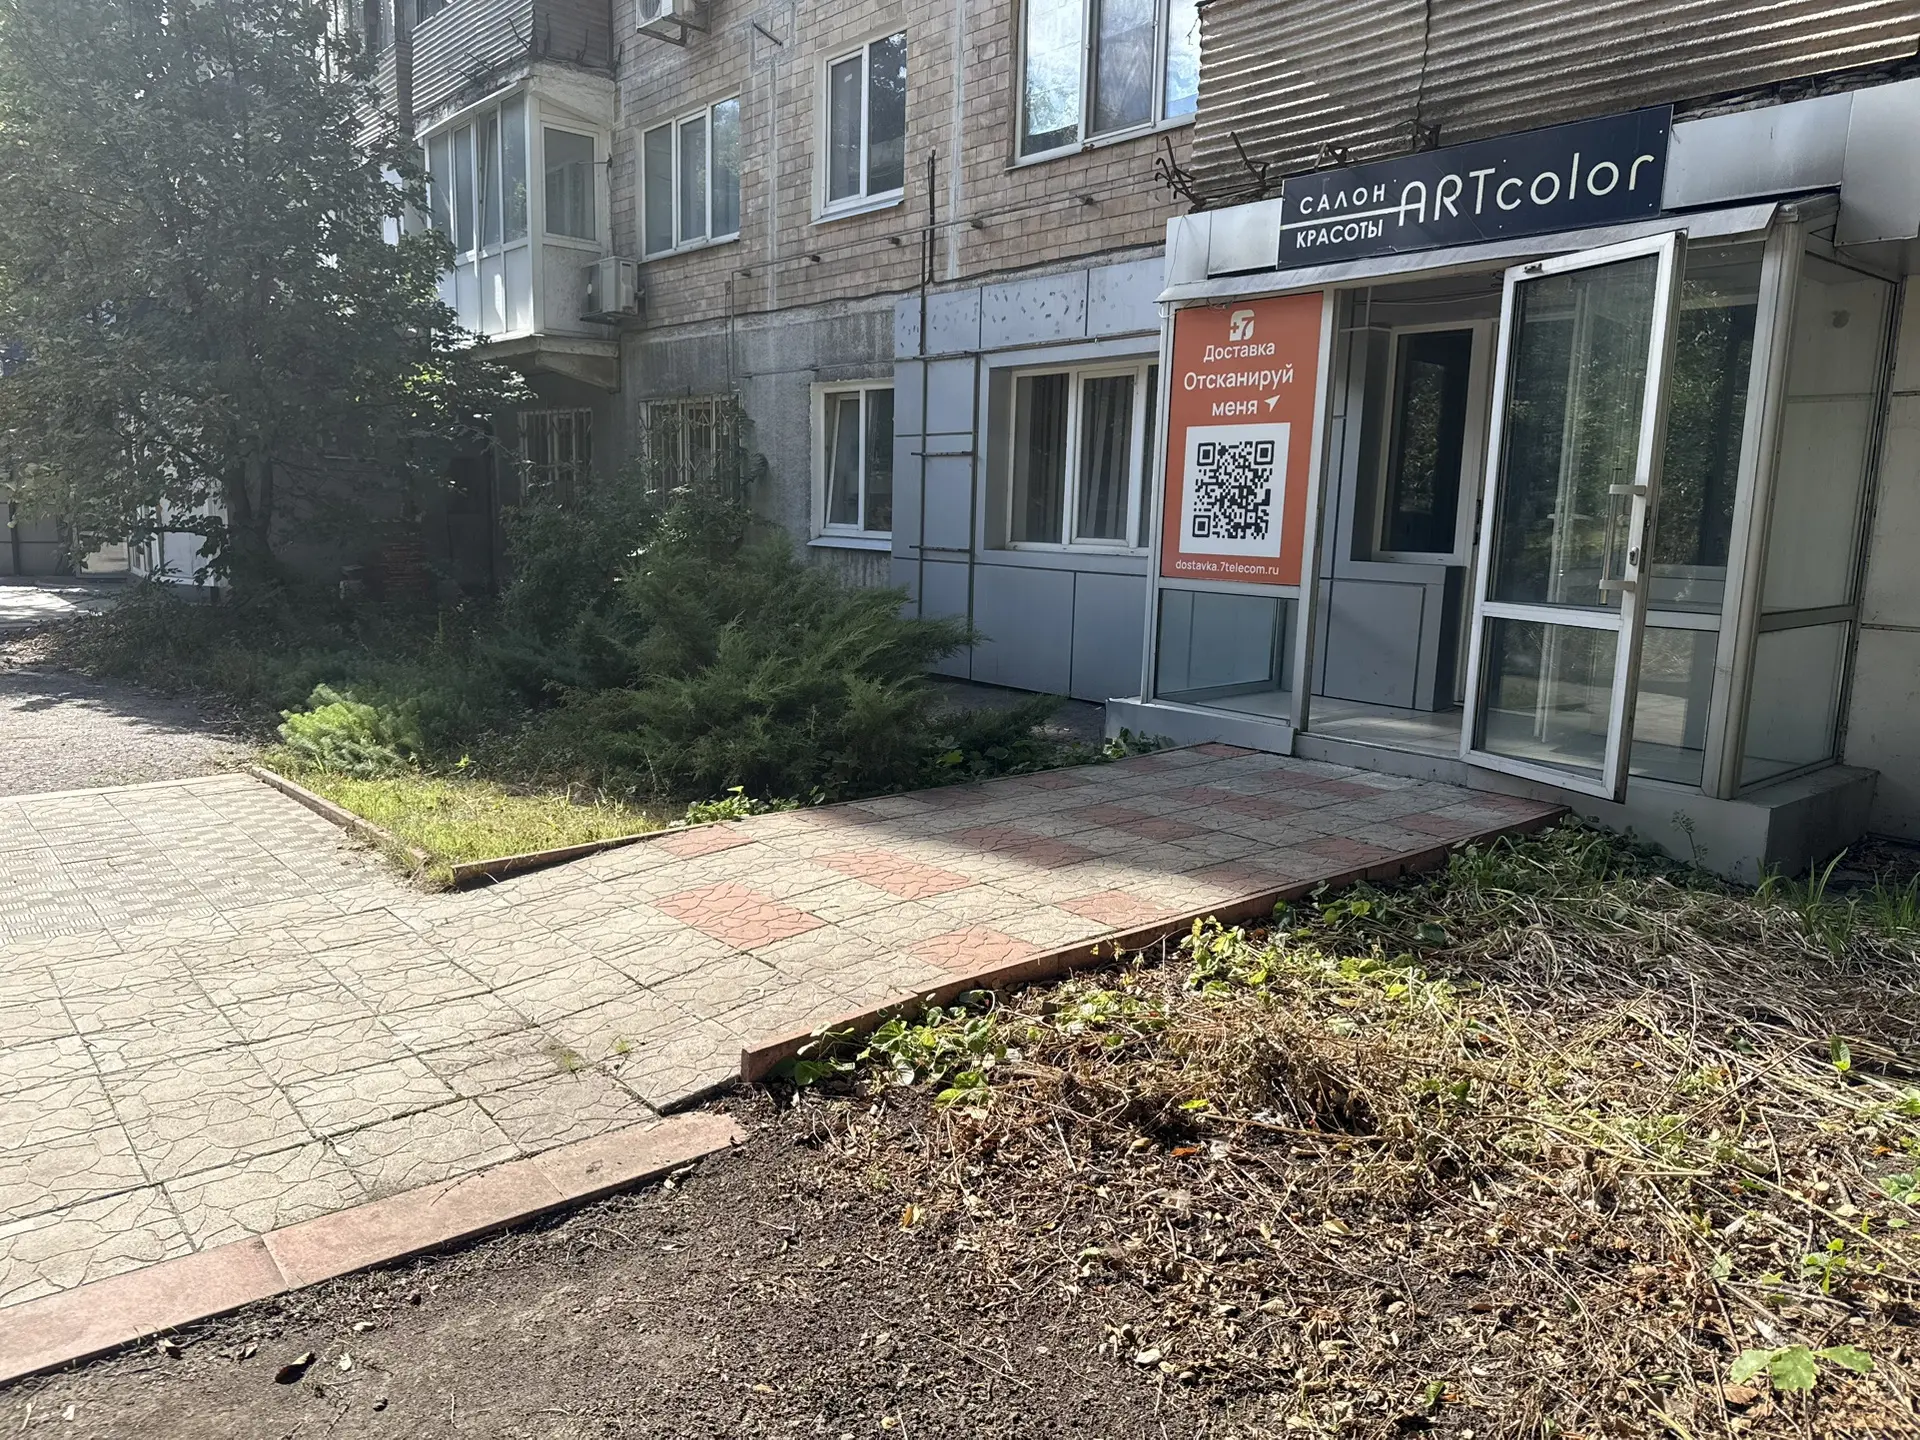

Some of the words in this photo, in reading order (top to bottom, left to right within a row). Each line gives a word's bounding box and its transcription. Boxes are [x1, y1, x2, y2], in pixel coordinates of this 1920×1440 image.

[1300, 183, 1385, 215] САЛОН
[1398, 152, 1655, 227] ARTcolor
[1296, 219, 1383, 249] КРАСОТЫ
[1203, 342, 1275, 363] Доставка
[1184, 363, 1294, 391] Отсканируй
[1212, 400, 1258, 416] меня
[1175, 559, 1280, 575] dostavka.7telecom.ru
